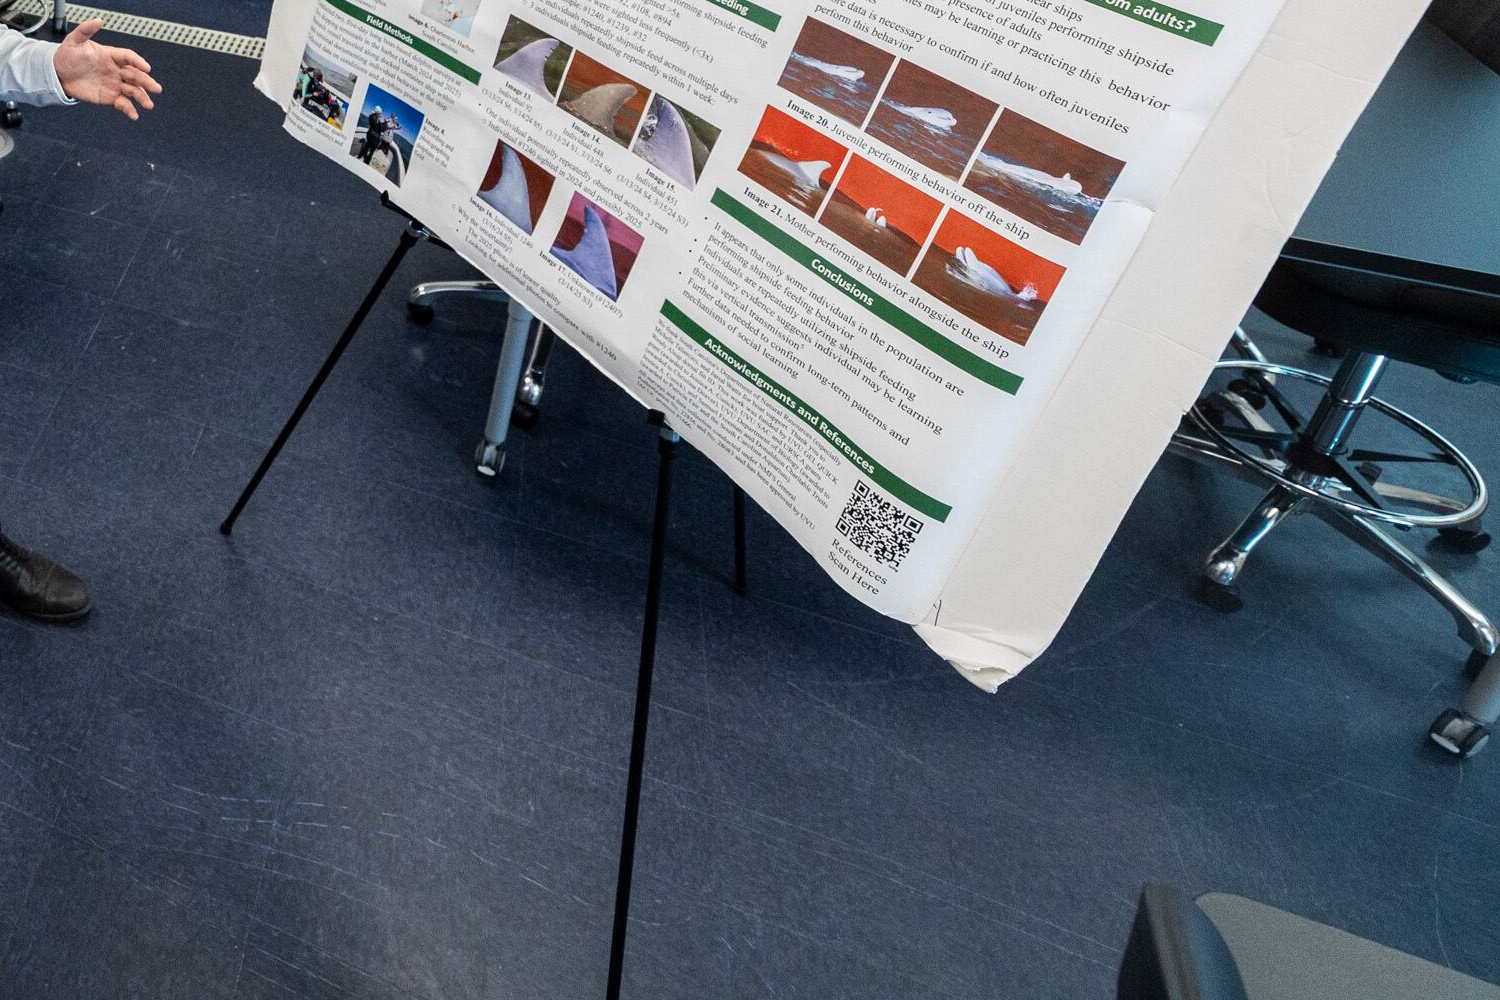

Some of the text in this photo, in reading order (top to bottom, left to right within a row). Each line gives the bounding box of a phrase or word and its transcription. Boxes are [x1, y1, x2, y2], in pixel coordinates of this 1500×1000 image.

[366, 15, 413, 44] Field Methods
[1133, 5, 1196, 32] adults?
[787, 99, 1029, 240] Image 20. Juvenile performing behavior off the ship
[744, 187, 1009, 358] Image 21. Mother performing behavior alongside the ship
[811, 259, 873, 305] Conclusions
[704, 338, 874, 473] Acknowledgments and References
[828, 551, 879, 594] Scan Here
[831, 538, 887, 584] References
